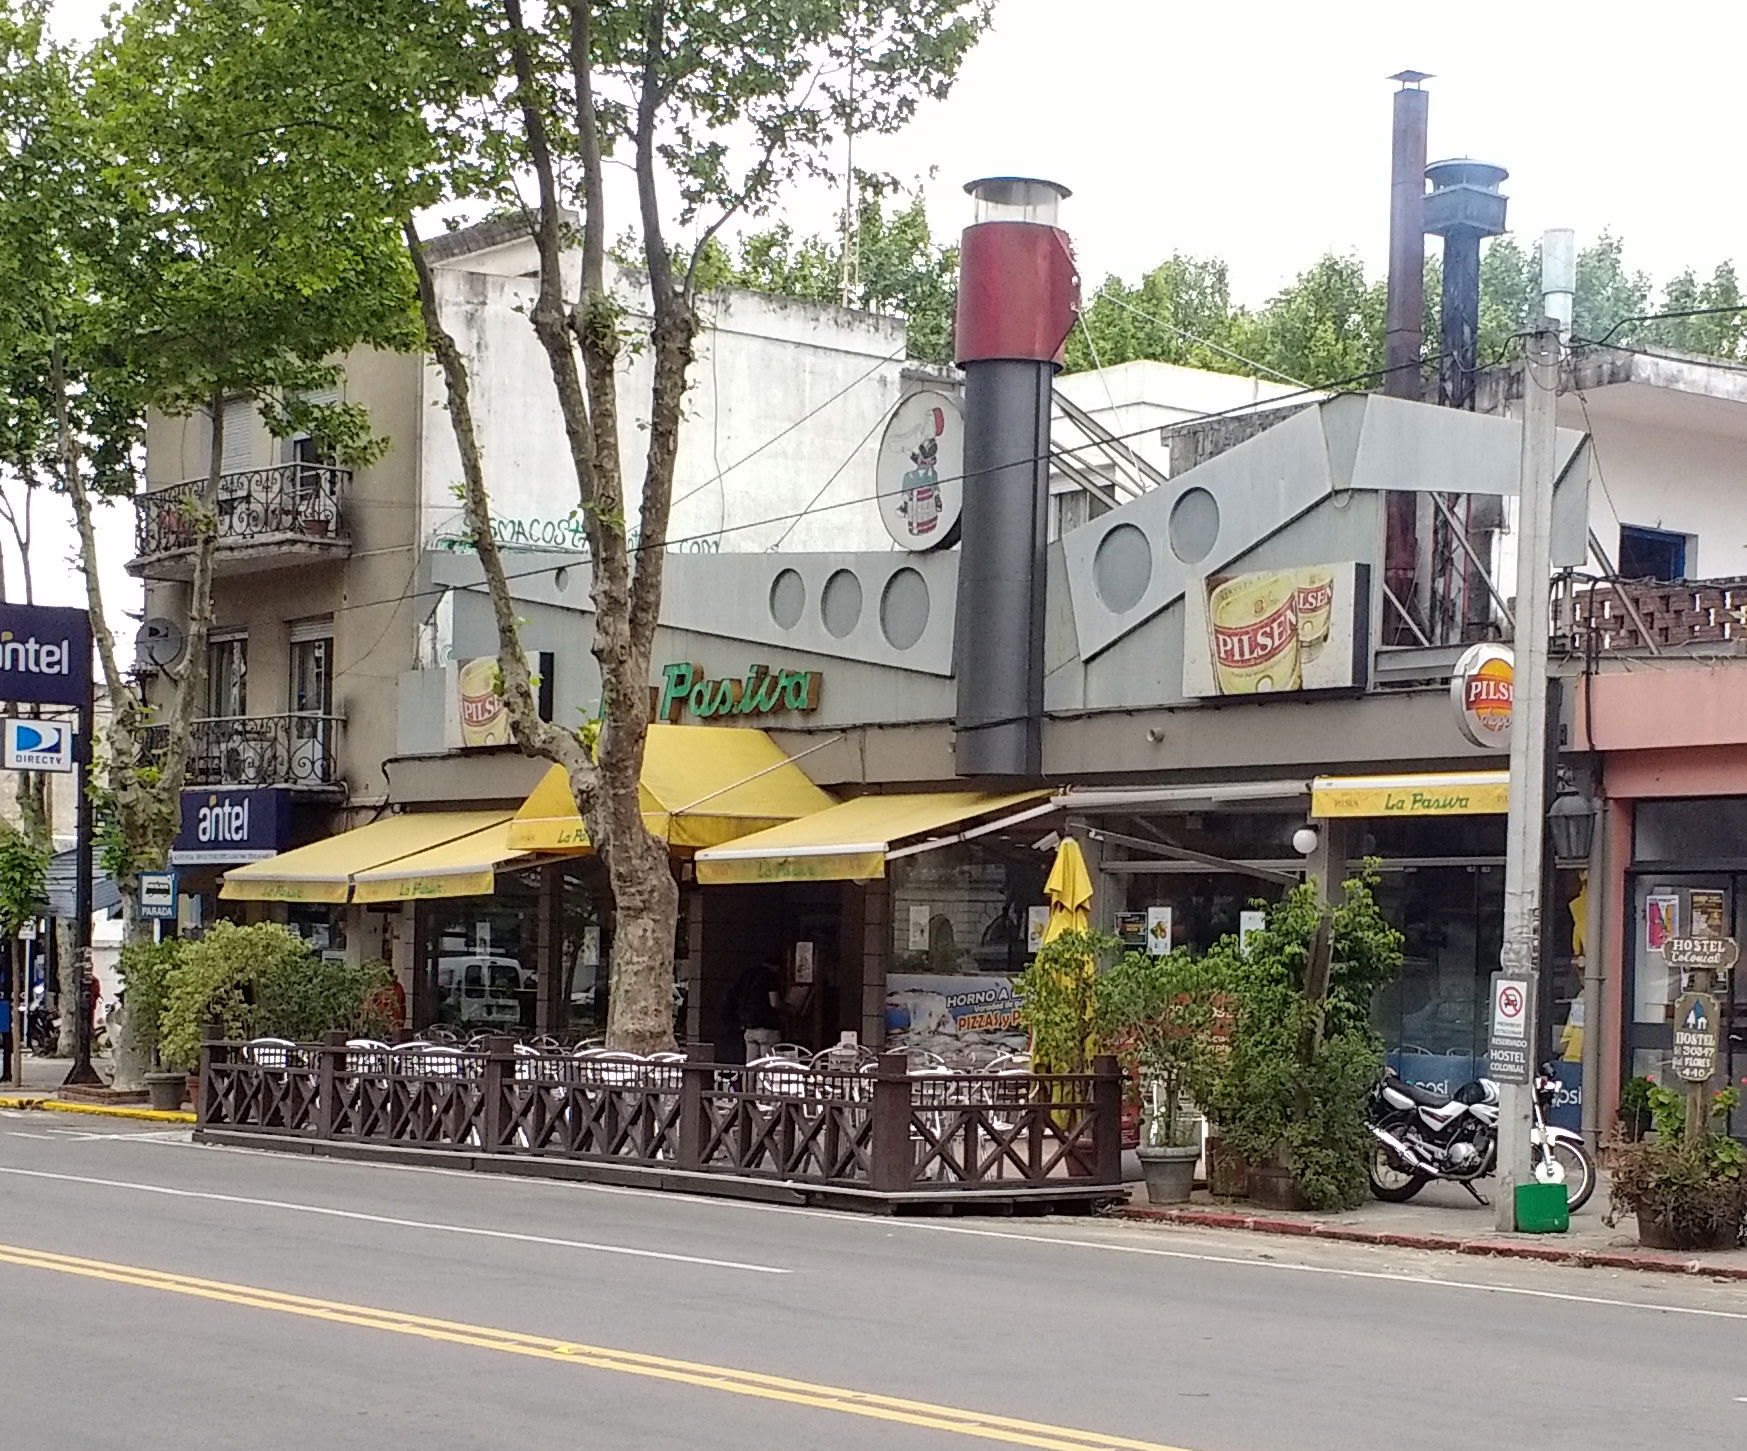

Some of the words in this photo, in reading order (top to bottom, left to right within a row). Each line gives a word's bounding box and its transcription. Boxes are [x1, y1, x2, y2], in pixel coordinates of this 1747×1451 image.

[1216, 592, 1298, 662] PILSEN
[0, 635, 69, 675] ntel
[660, 661, 823, 721] Pasiva
[15, 754, 62, 765] DIRECTV
[1385, 793, 1405, 811] La
[1410, 792, 1470, 811] Pasiva
[198, 797, 249, 842] antel
[141, 906, 173, 916] PARADA
[1673, 940, 1726, 953] HOSTEL
[1671, 951, 1722, 964] Colonial
[946, 991, 996, 1008] HORNO
[998, 988, 1010, 1000] A
[957, 1012, 999, 1031] PIZZAS
[1675, 1032, 1716, 1046] HOSTEL
[1490, 1049, 1526, 1064] HOSTEL
[1489, 1061, 1525, 1074] COLONIAL
